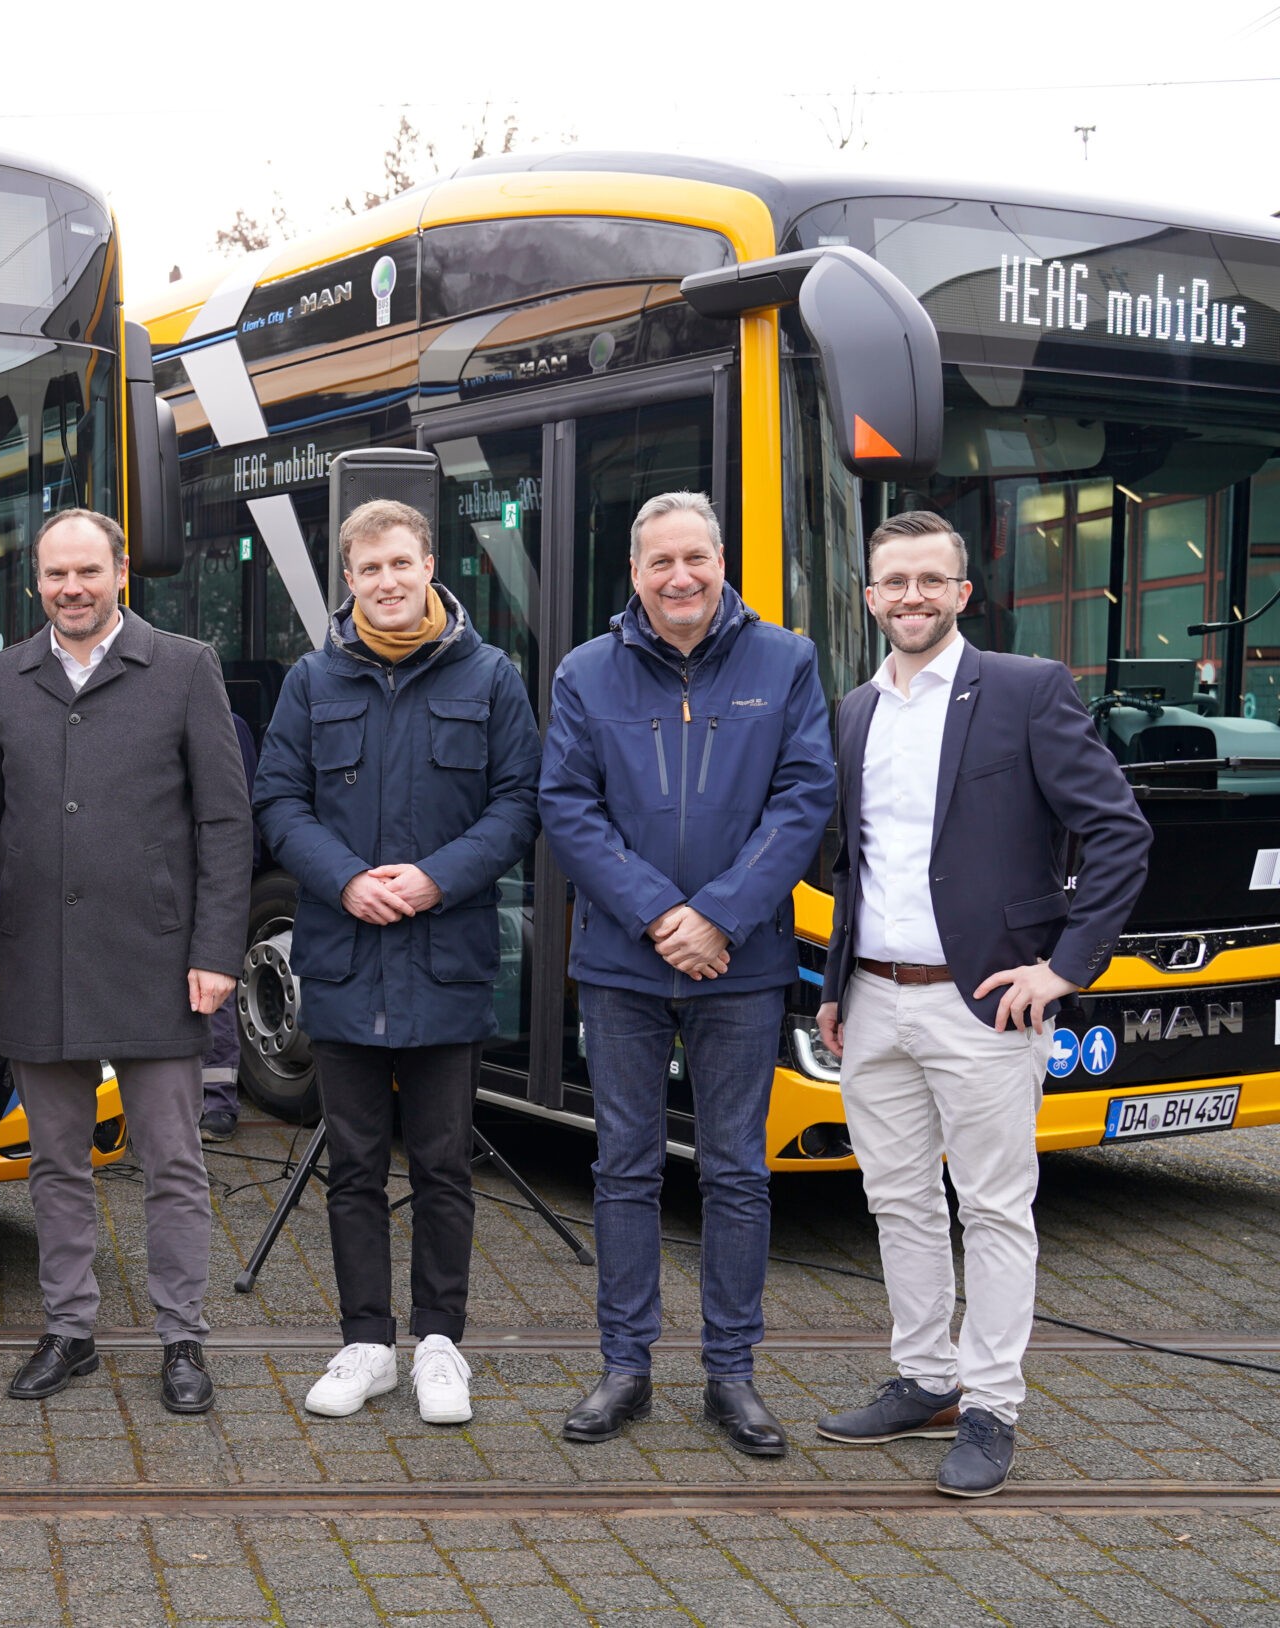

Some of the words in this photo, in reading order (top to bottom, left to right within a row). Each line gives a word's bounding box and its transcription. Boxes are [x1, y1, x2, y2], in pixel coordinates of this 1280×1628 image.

[299, 280, 353, 315] MAN
[999, 253, 1089, 331] HEAG
[1106, 273, 1247, 348] mobiBus
[234, 452, 268, 493] HEAG
[273, 442, 333, 486] mobiBus
[1122, 1001, 1244, 1044] MAN
[1120, 1102, 1149, 1132] DA
[1162, 1097, 1194, 1128] BH
[1194, 1093, 1235, 1124] 430
